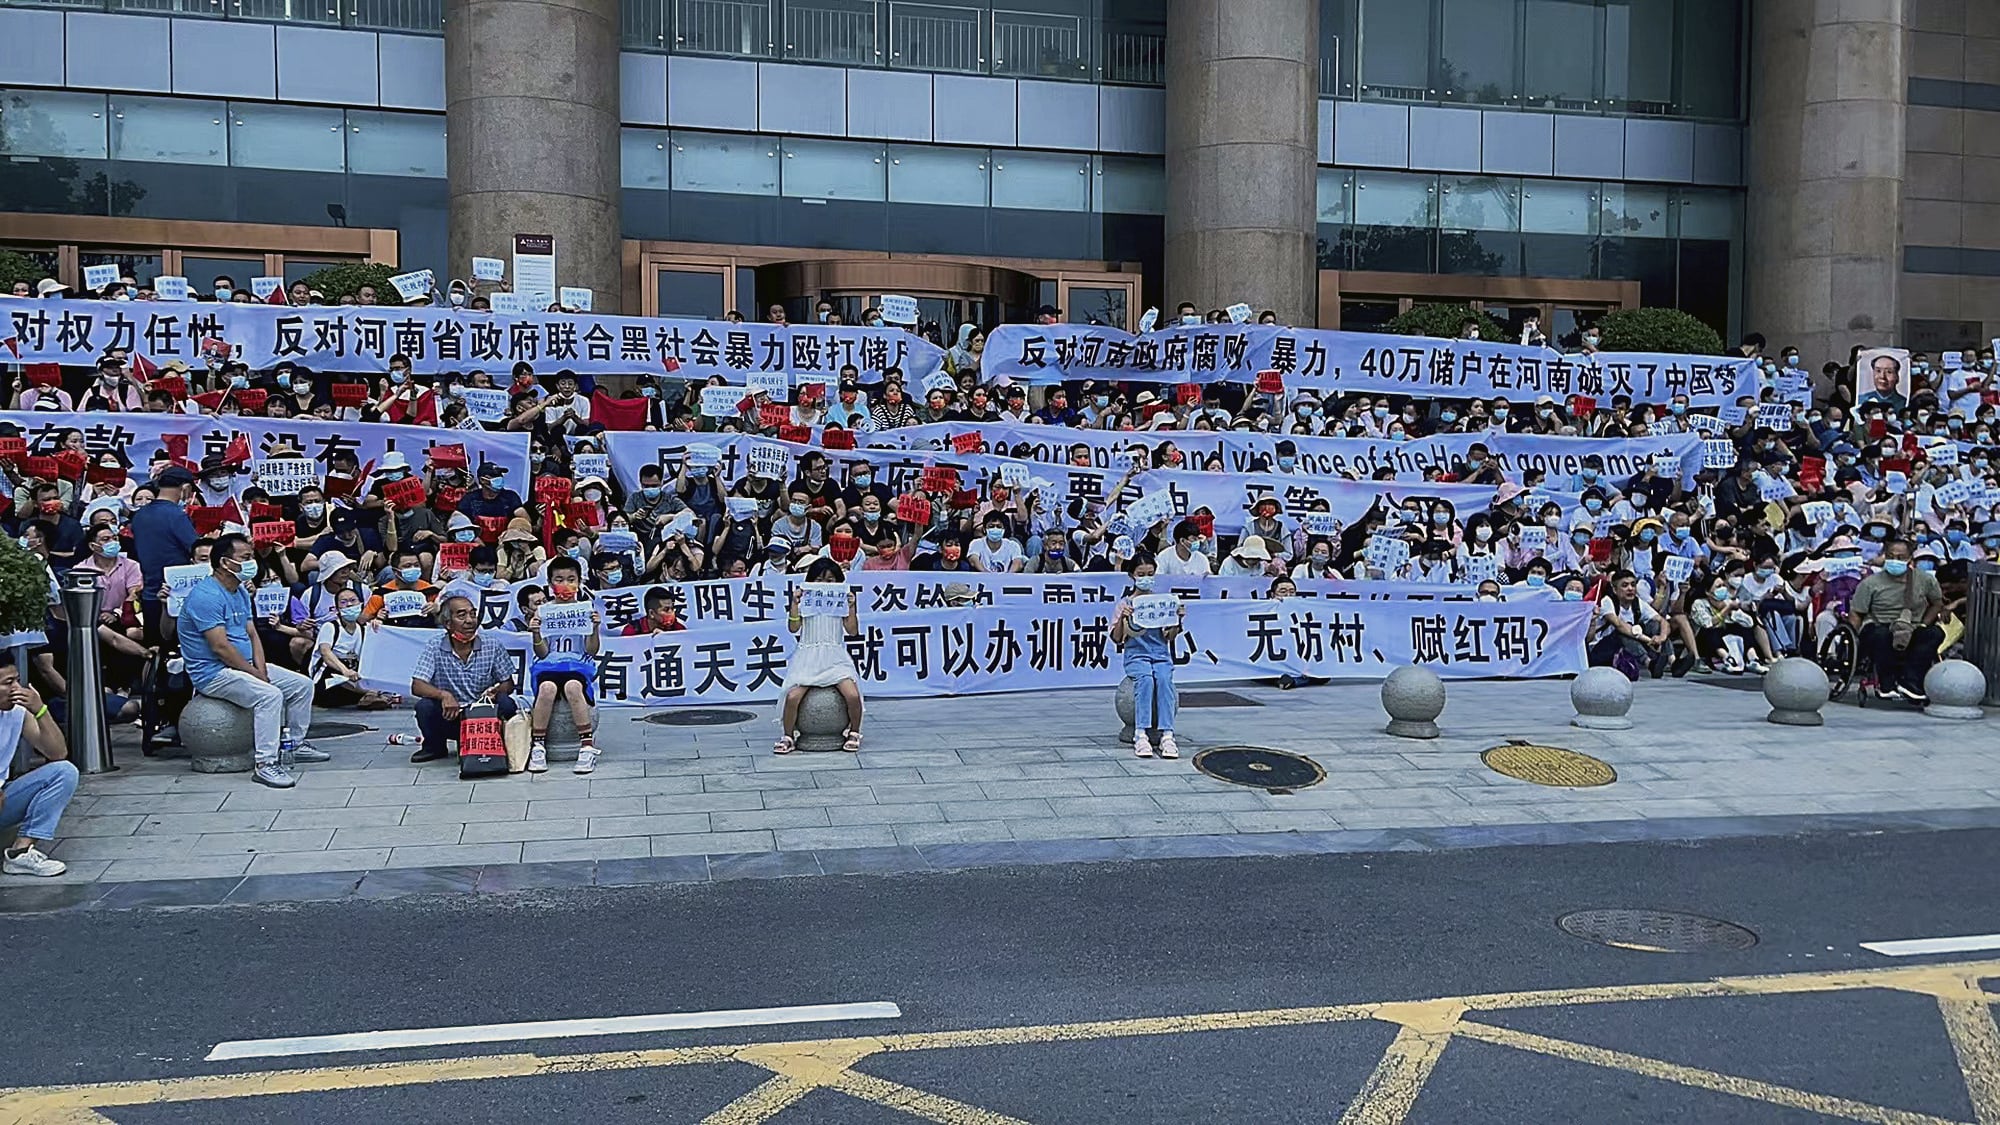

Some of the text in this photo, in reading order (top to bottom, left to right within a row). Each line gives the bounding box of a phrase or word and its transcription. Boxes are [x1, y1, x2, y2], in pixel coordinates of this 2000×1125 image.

[1231, 442, 1351, 476] vince
[1430, 444, 1511, 473] Hen
[556, 638, 572, 652] 10
